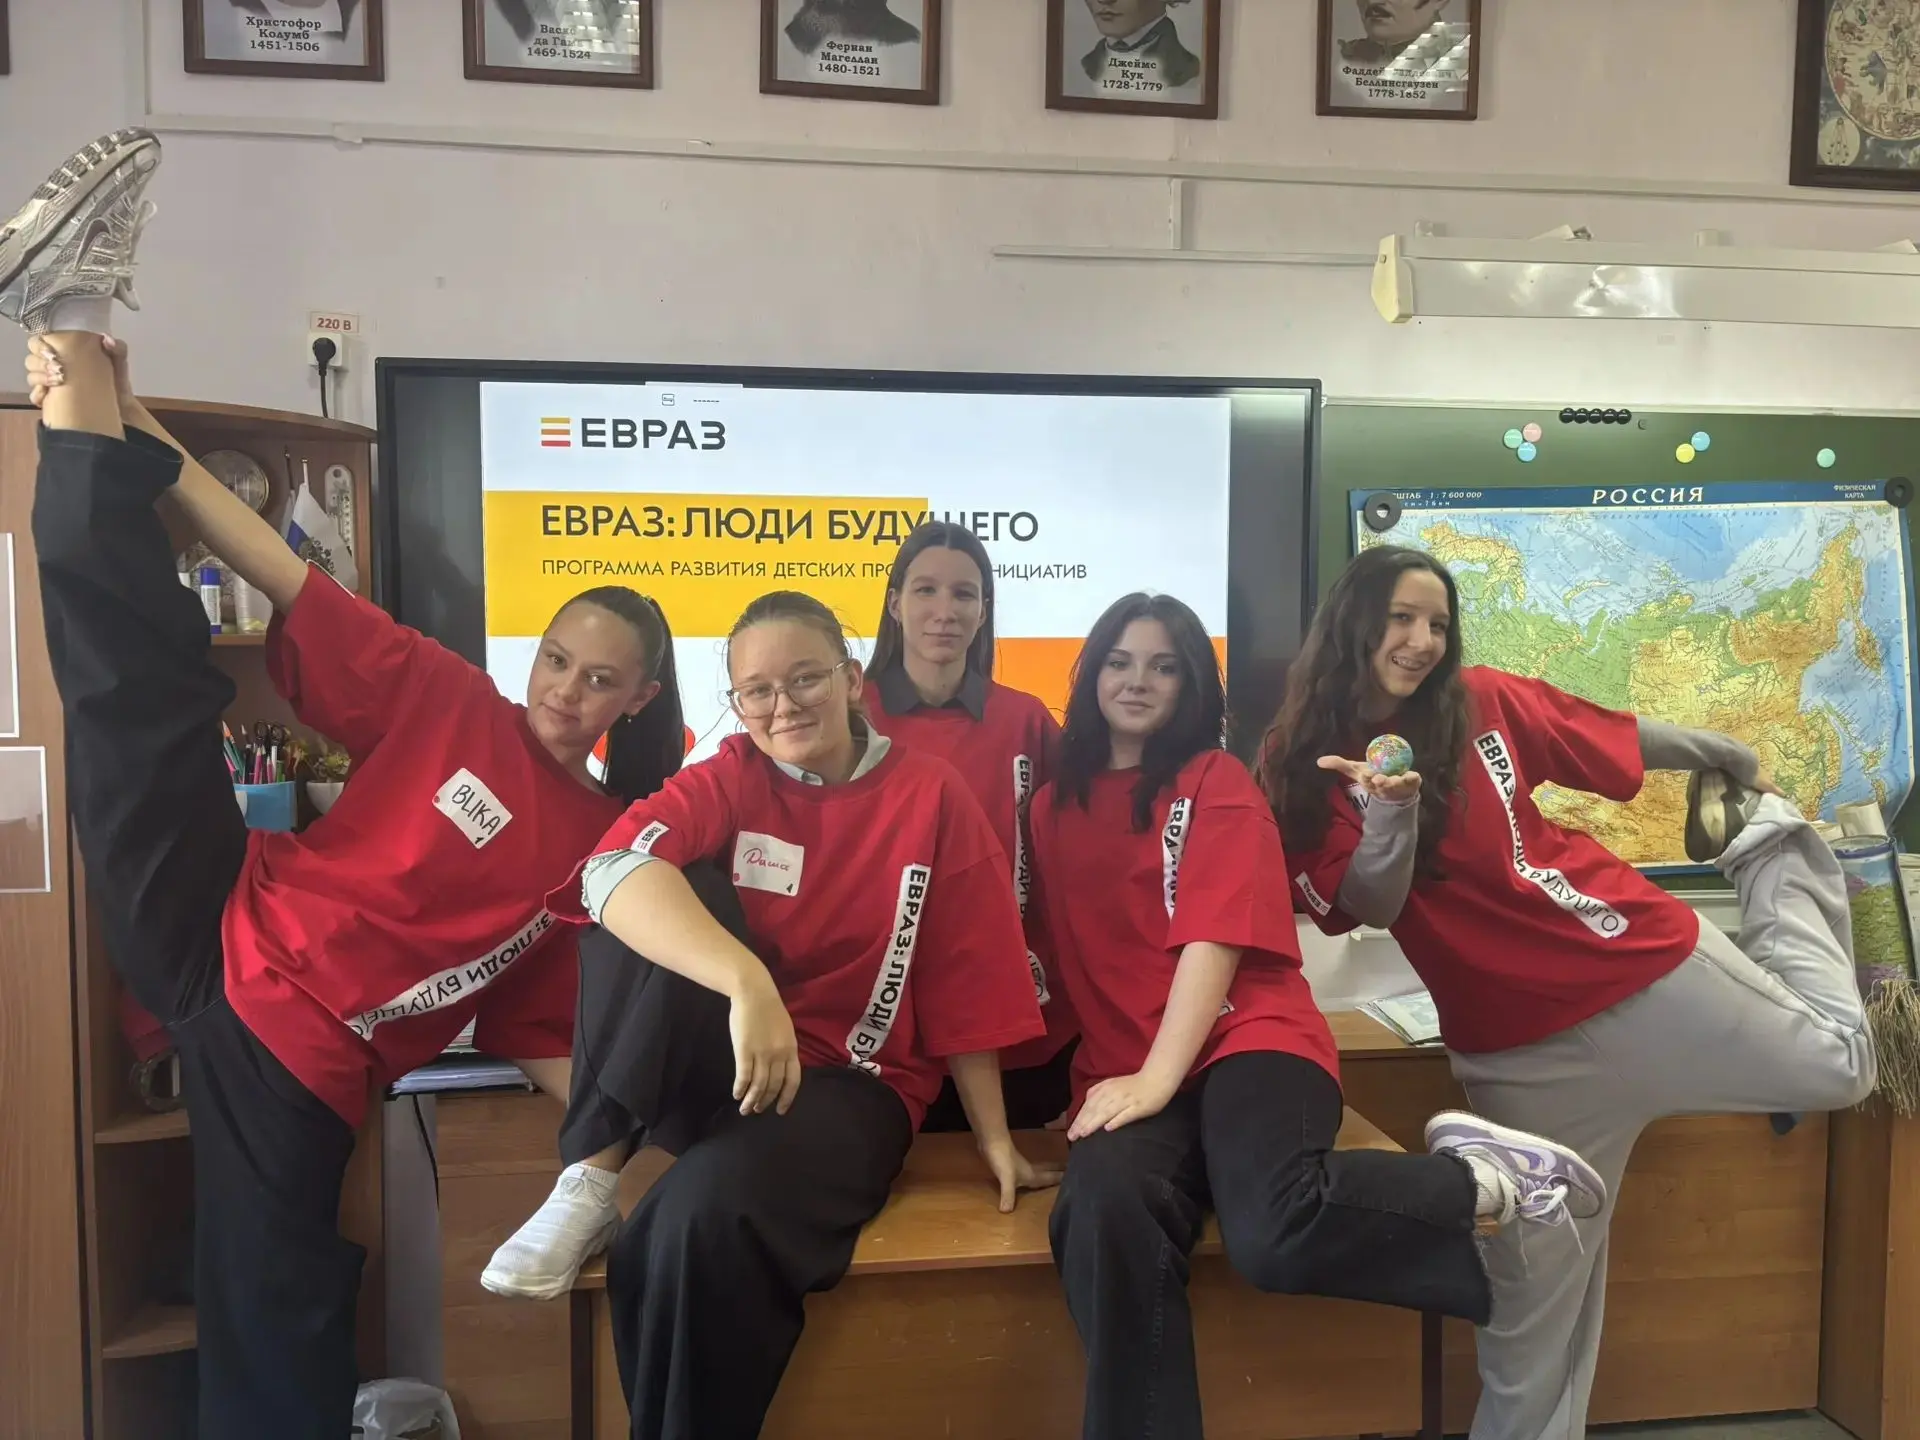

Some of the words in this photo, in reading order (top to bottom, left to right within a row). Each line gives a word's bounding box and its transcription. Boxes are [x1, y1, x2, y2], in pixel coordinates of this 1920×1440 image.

[246, 16, 321, 31] Христофор
[259, 29, 310, 40] Колумб
[250, 40, 320, 52] 1451-1506
[533, 38, 548, 46] да
[826, 40, 873, 53] Фернан
[527, 47, 591, 59] 1469-1524
[820, 51, 878, 64] Магеллан
[818, 63, 880, 76] 1480-1521
[1108, 57, 1157, 69] Джеймс
[1121, 69, 1144, 80] Кук
[1103, 80, 1163, 91] 1728-1779
[1355, 78, 1439, 89] Беллинсгаузен
[1368, 89, 1426, 99] 1778-1852
[317, 317, 340, 330] 220
[343, 320, 352, 331] В
[581, 418, 726, 450] ЕВРАЗ
[1592, 486, 1704, 505] РОССИЯ
[542, 559, 664, 576] ПРОГРАММА
[671, 560, 766, 577] РАЗВИТИЯ
[773, 562, 855, 580] ДЕТСКИХ
[992, 564, 1087, 581] НИЦИАТИВ
[452, 784, 500, 835] BLIKA
[466, 935, 533, 983] ЛЮДИ
